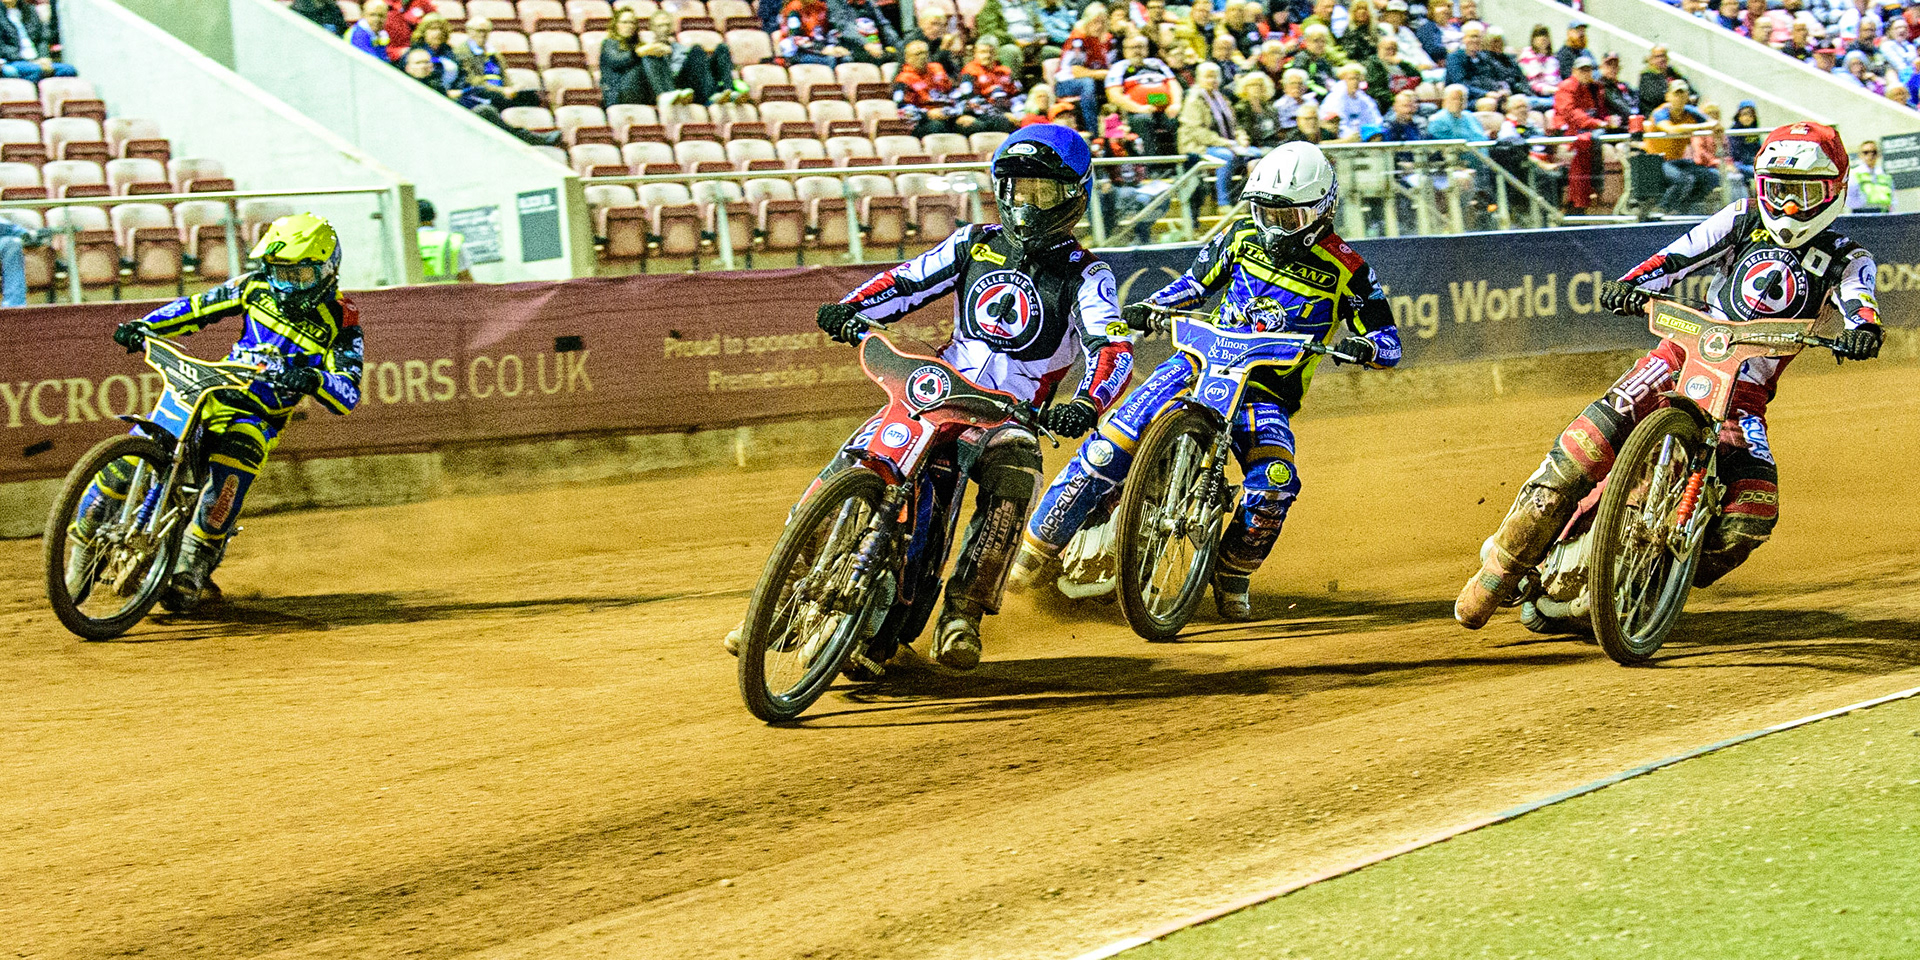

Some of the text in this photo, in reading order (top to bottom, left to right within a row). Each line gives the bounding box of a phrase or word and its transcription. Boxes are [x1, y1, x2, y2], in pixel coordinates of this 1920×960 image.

[1744, 251, 1806, 296] BELLE VUE ACES
[974, 274, 1005, 294] BELLE
[1009, 274, 1029, 289] VUE
[1450, 273, 1557, 323] World
[664, 333, 721, 358] Proud
[723, 335, 744, 355] to
[746, 331, 820, 356] sponsor
[1208, 344, 1221, 358] &
[1215, 336, 1249, 350] Minors
[1207, 387, 1226, 397] ATPI
[887, 429, 905, 442] ATPI
